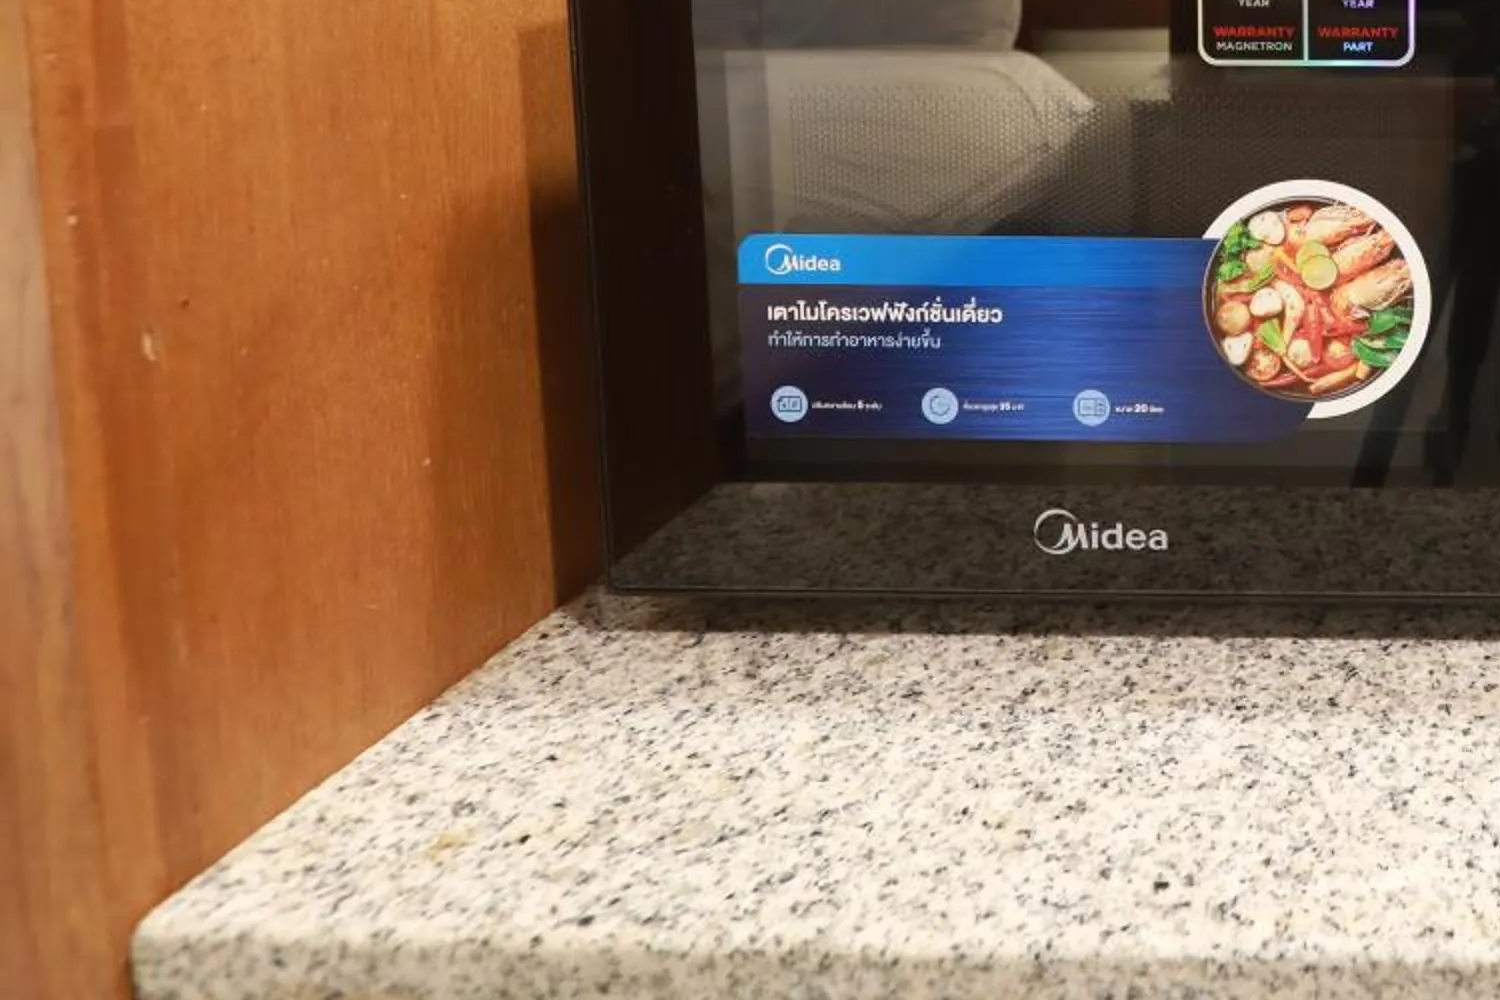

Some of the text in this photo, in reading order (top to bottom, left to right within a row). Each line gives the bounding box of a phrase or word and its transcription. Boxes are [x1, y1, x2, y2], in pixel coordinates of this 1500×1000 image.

[1341, 0, 1375, 9] YEAR
[1213, 26, 1296, 38] WARRANTY
[1318, 27, 1399, 38] WARRANTY
[1216, 41, 1293, 51] MAGNETRON
[1343, 42, 1373, 52] PART
[765, 244, 841, 275] Midea
[1034, 509, 1169, 555] Midea
